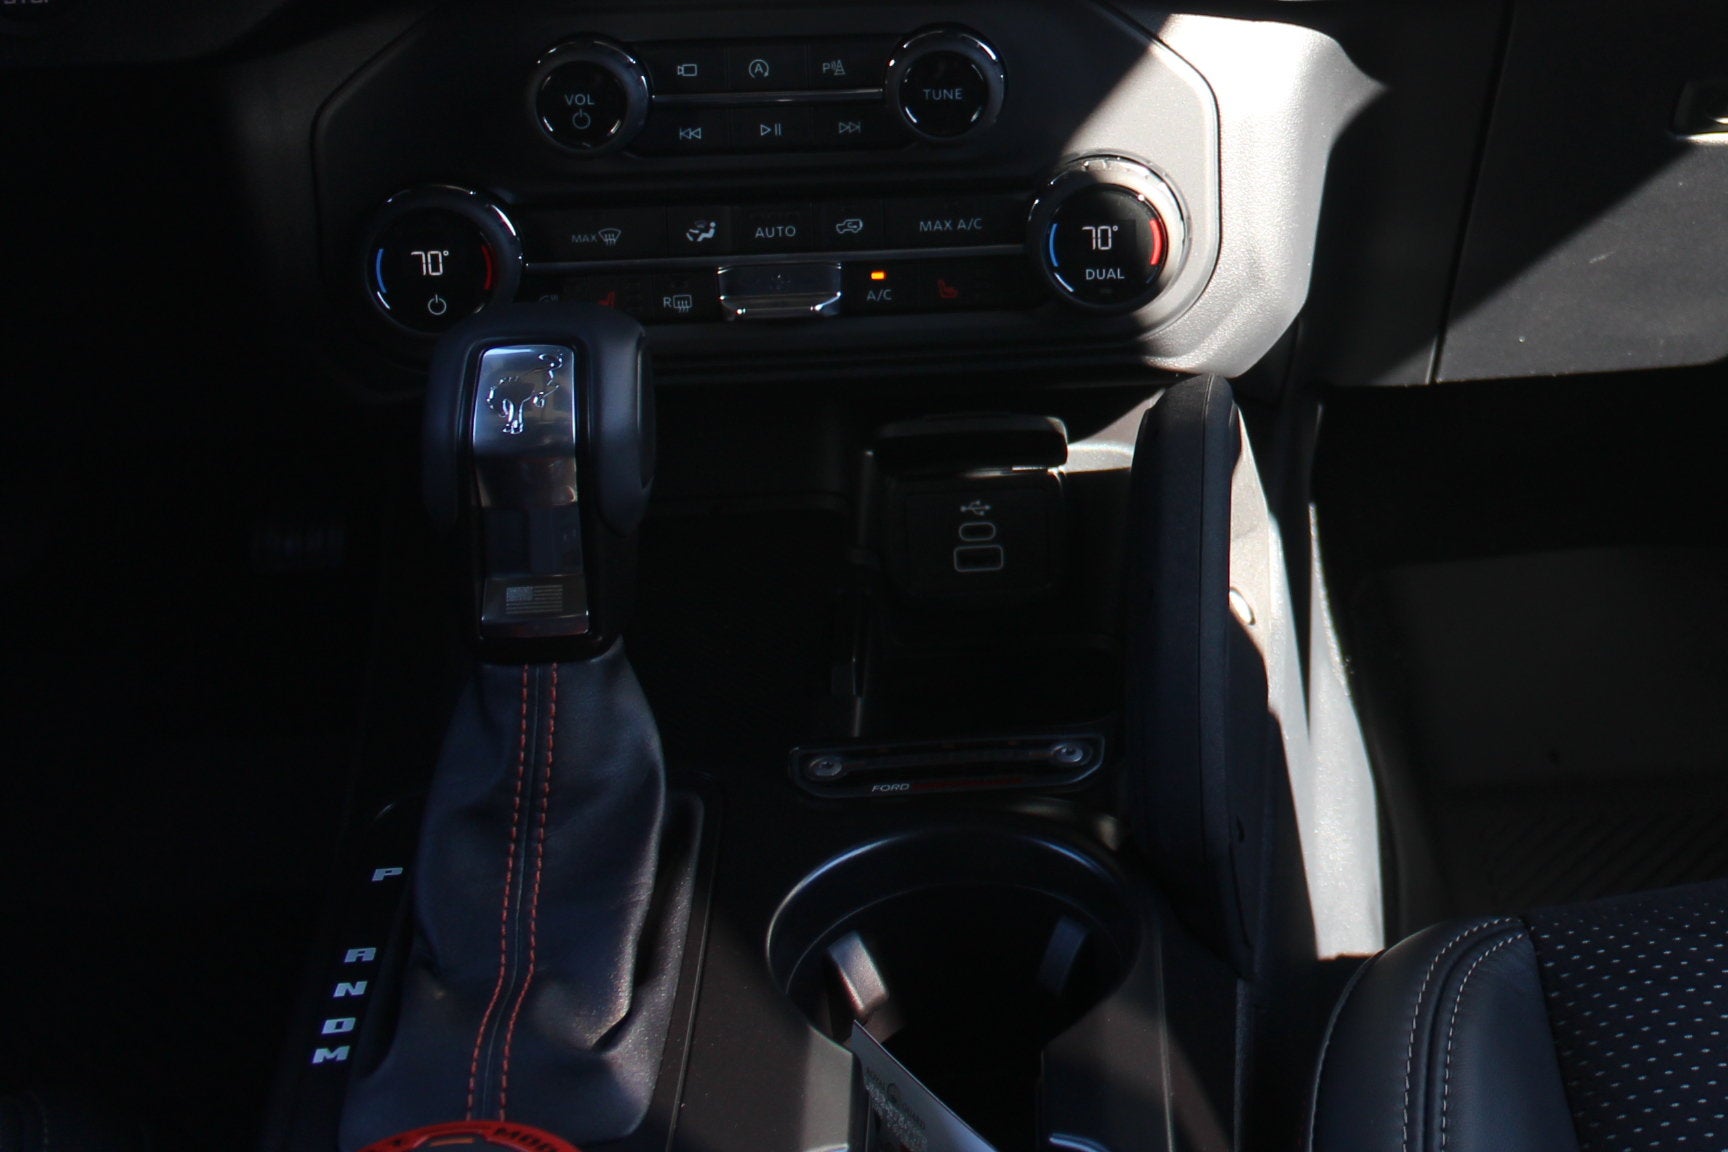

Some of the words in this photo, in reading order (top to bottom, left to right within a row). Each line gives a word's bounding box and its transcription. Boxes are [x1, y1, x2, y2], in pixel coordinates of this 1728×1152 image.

[564, 93, 595, 107] VOL
[922, 88, 963, 101] TUNE
[755, 225, 796, 239] AUTO
[919, 220, 952, 233] MAX
[956, 218, 984, 232] A/C
[571, 234, 598, 244] MAX
[1085, 267, 1125, 281] DUAL
[866, 288, 893, 302] A/C
[871, 783, 911, 793] FORD
[371, 866, 404, 882] P
[332, 980, 368, 998] N
[321, 1016, 356, 1035] D
[312, 1045, 350, 1065] M
